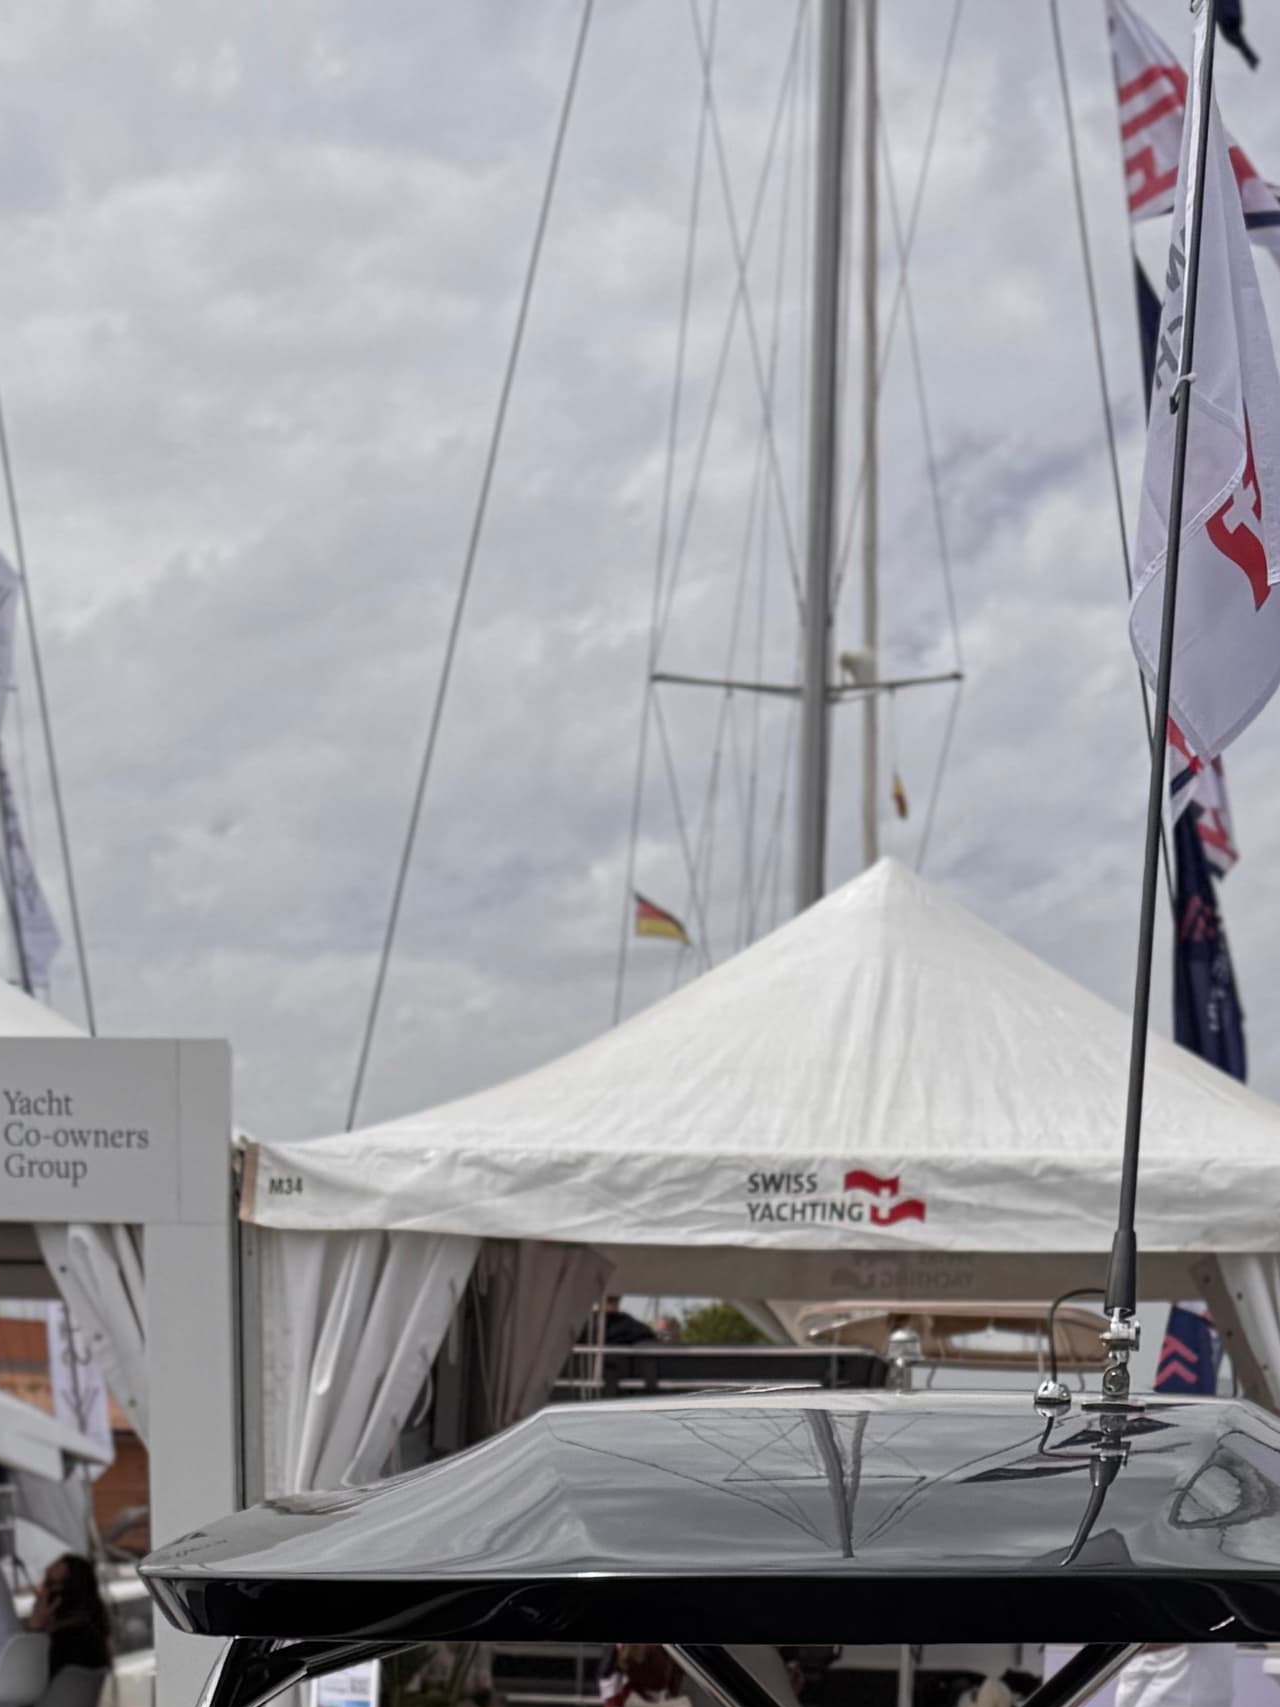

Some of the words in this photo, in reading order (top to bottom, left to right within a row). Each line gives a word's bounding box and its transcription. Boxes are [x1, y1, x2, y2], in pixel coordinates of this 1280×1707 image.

[4, 1090, 73, 1117] Yacht
[4, 1122, 150, 1148] Co-owners
[4, 1154, 89, 1187] Group
[747, 1173, 818, 1194] SWISS
[747, 1201, 864, 1223] YACHTING
